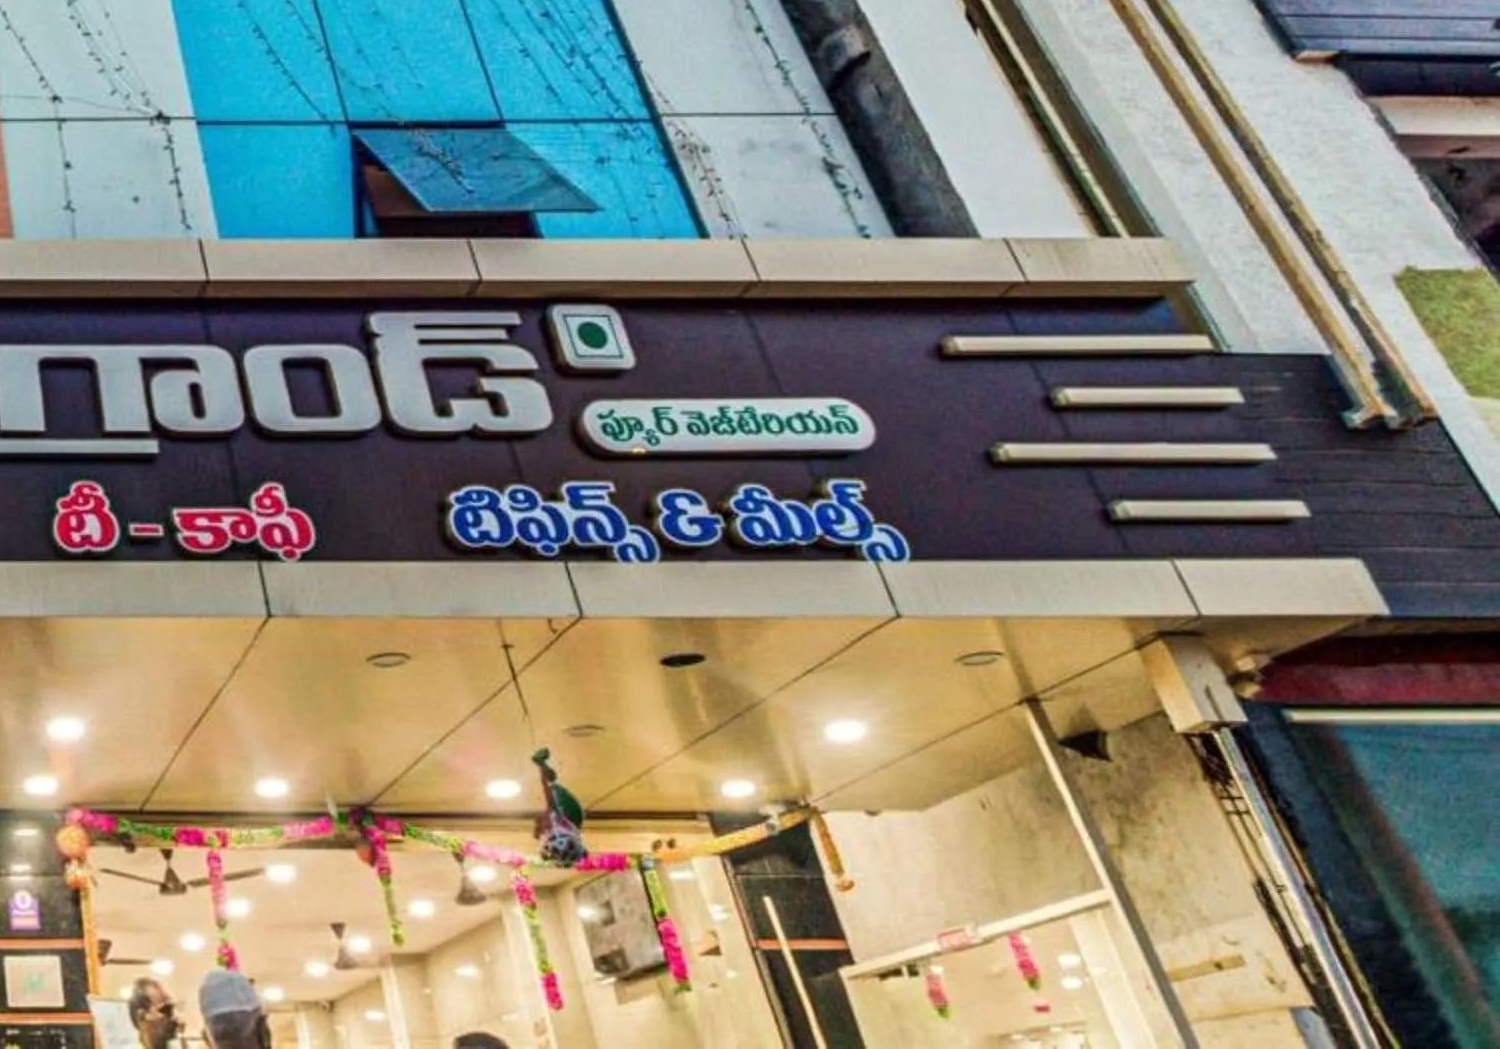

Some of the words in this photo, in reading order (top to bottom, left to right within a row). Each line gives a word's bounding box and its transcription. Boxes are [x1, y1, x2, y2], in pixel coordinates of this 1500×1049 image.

[597, 405, 678, 446] ప్యూర్
[172, 483, 316, 562] కాఫీ
[448, 481, 660, 563] టిఫిన్స్
[656, 488, 725, 546] &
[725, 479, 911, 563] మీల్స్
